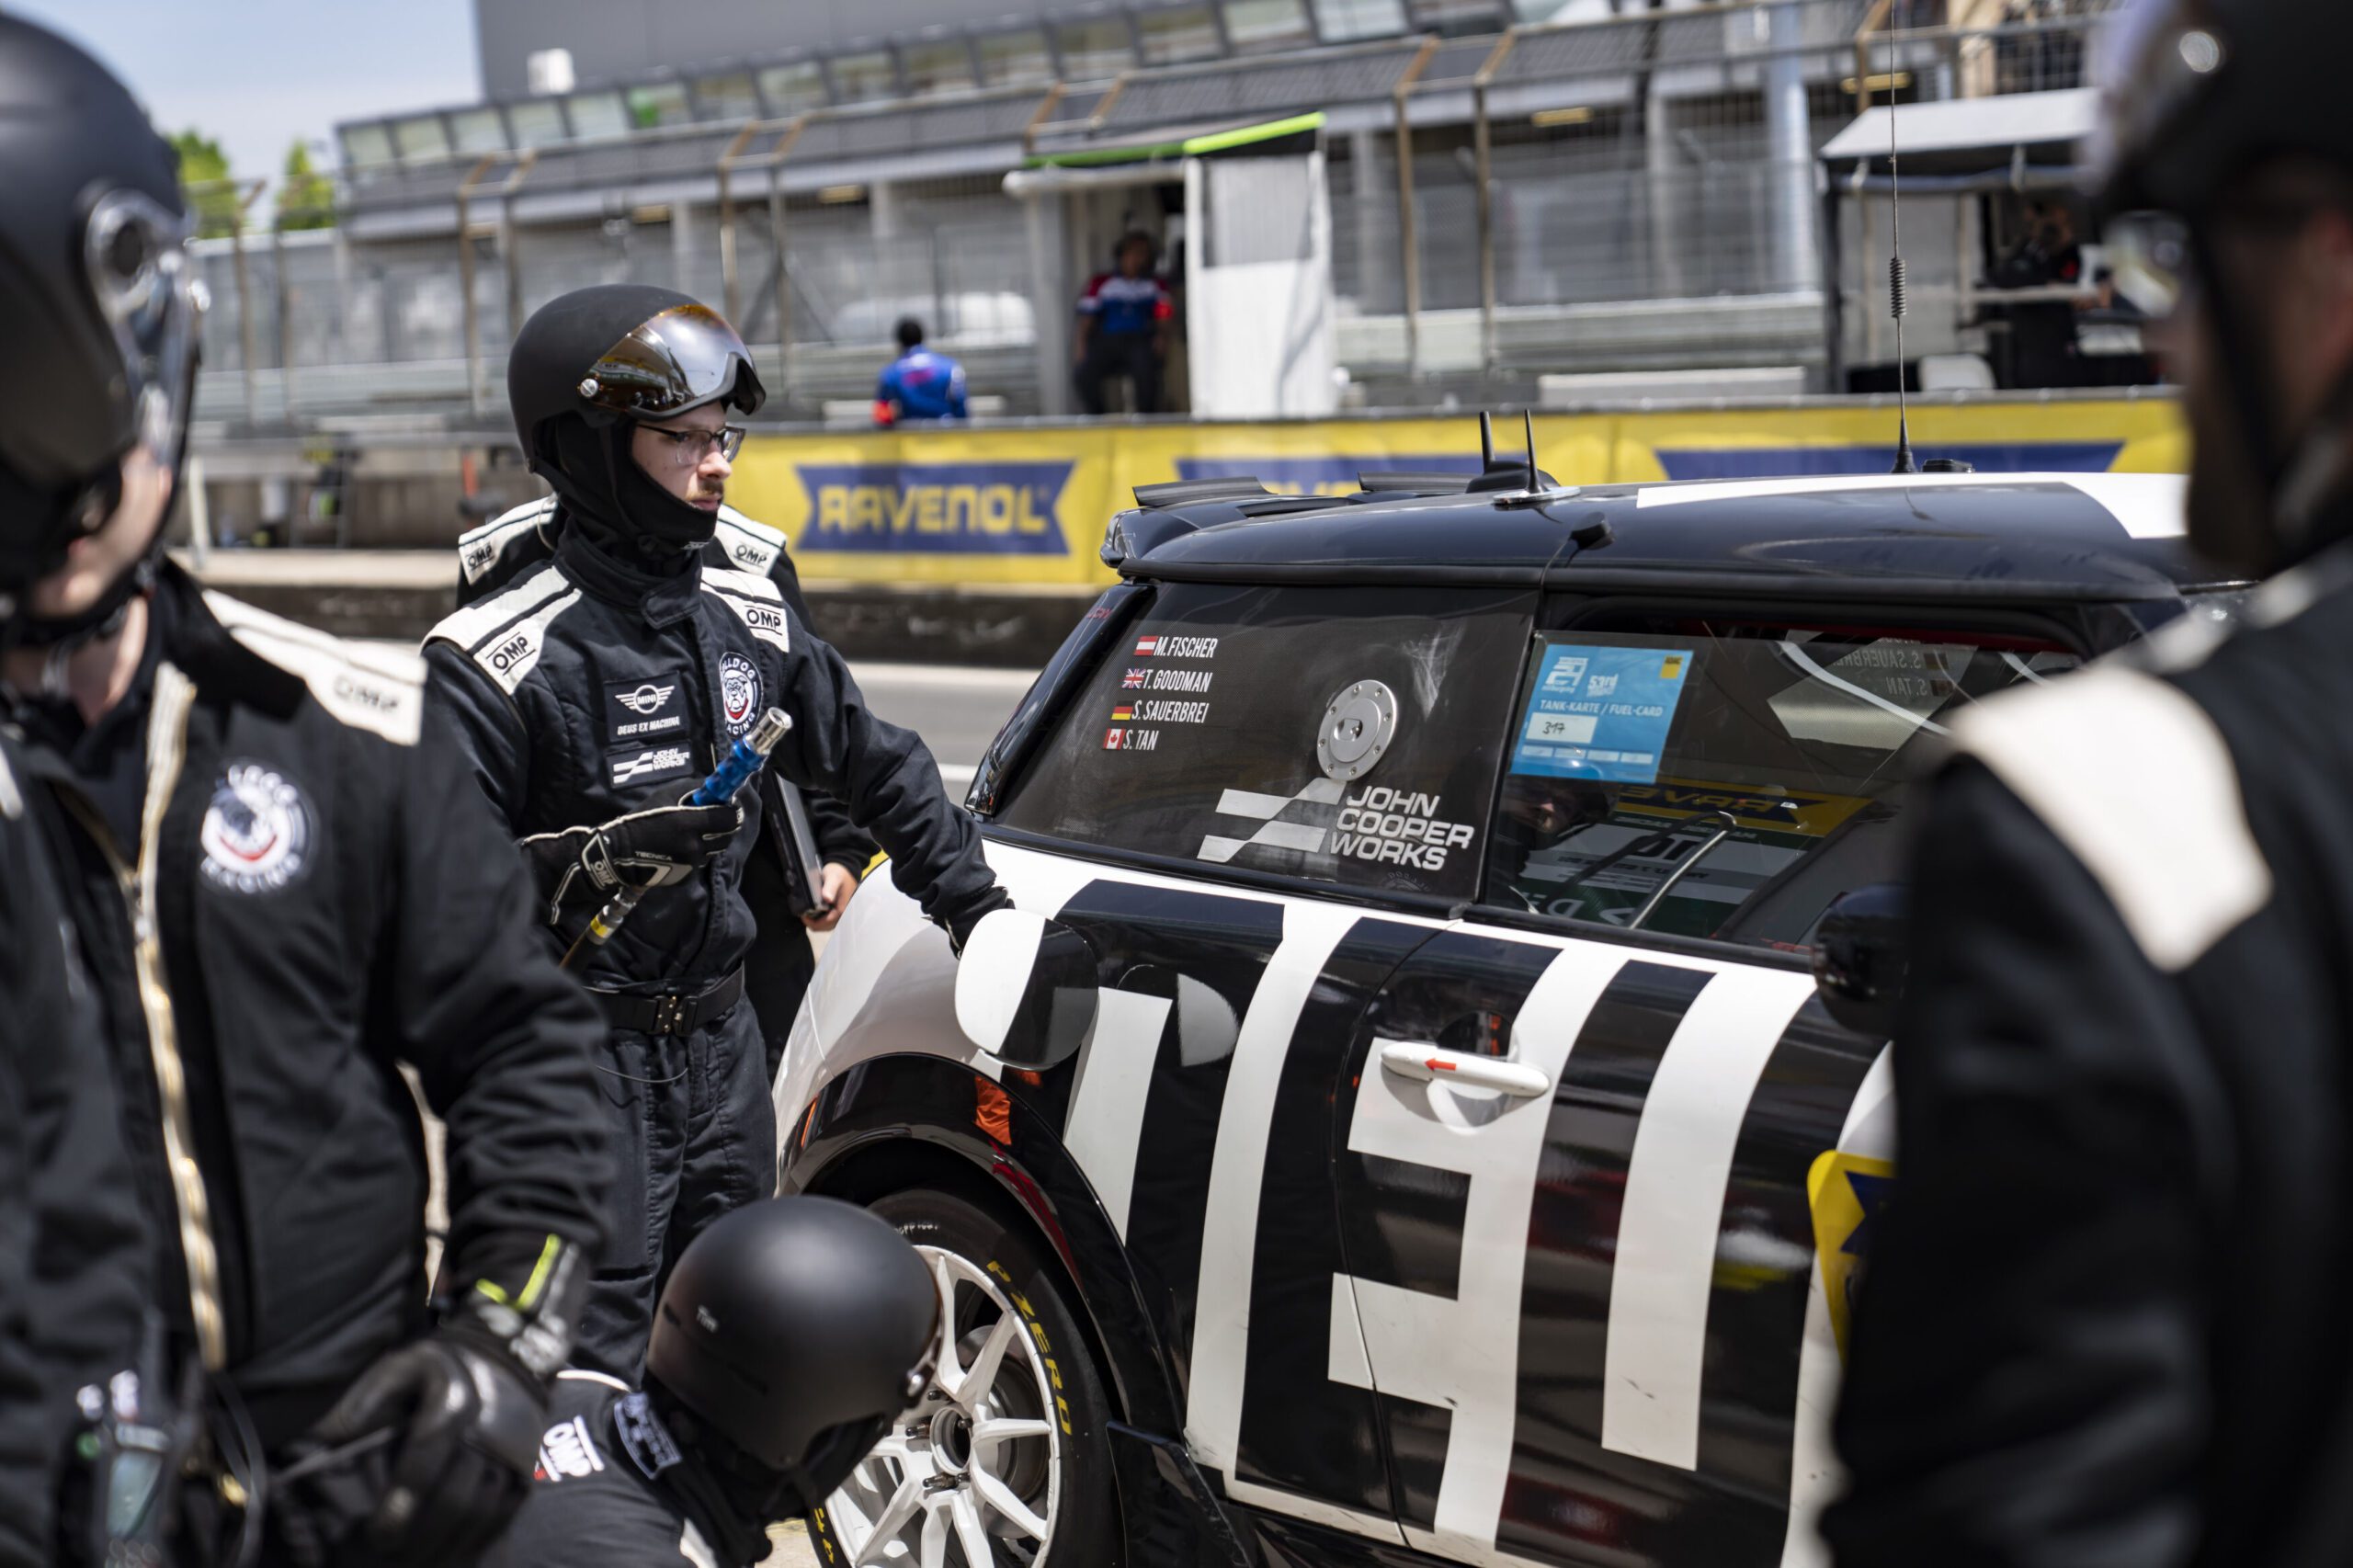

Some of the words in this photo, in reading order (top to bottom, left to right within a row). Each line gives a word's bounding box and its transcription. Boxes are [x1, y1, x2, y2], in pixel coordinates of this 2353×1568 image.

[818, 483, 1047, 533] RAVENOL
[468, 543, 492, 568] OMP
[736, 544, 767, 563] OMP
[746, 608, 780, 629] OMP
[493, 636, 528, 670] OMP
[637, 694, 656, 705] MINI
[1540, 699, 1600, 714] TANK-KARTE
[1608, 704, 1663, 717] FUEL-CARD
[618, 723, 638, 735] DEUS
[638, 722, 648, 733] EX
[649, 716, 680, 731] MACHINA
[1542, 722, 1565, 735] 317
[1347, 785, 1440, 817] JOHN
[1336, 808, 1474, 849] COOPER
[634, 850, 673, 861] TECNICA
[1330, 831, 1448, 870] WORKS
[594, 860, 615, 884] OMP
[986, 1260, 1011, 1282] P
[1011, 1290, 1073, 1436] ZERO
